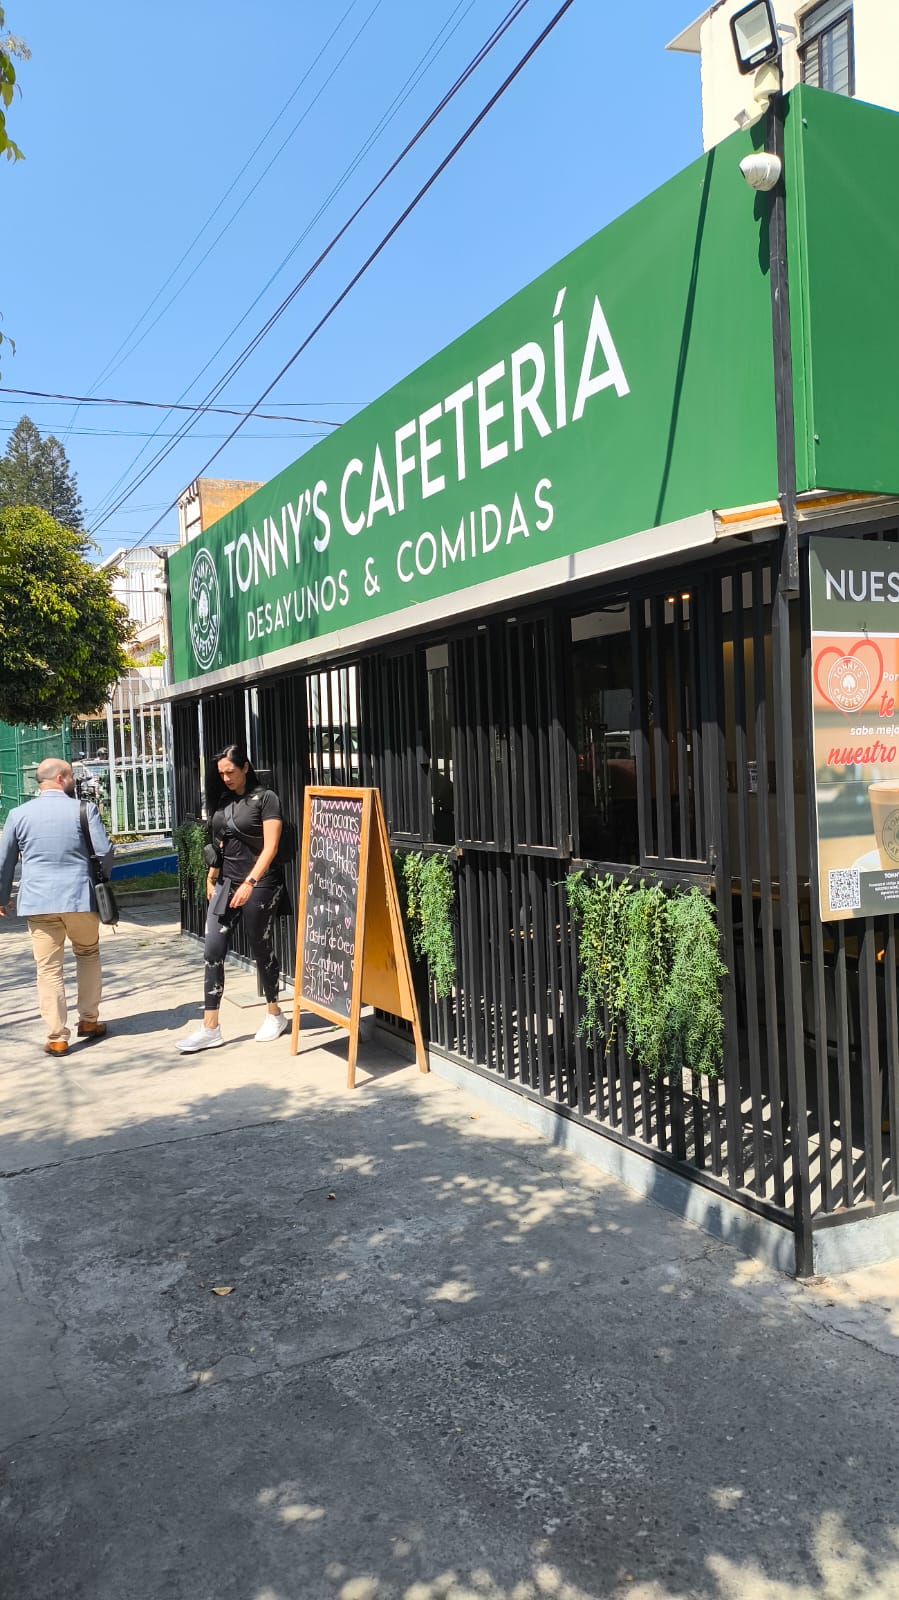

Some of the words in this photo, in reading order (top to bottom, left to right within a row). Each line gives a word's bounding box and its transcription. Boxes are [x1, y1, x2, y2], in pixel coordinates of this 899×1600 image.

[224, 479, 332, 599] TONNY'S
[340, 286, 631, 537] CAFETERÍA
[246, 568, 350, 642] DESAYUNOS
[364, 556, 381, 598] &
[396, 477, 555, 584] COMIDAS
[825, 569, 899, 603] NUES
[879, 690, 896, 718] te
[850, 726, 875, 736] sabe
[827, 740, 897, 766] nuestro
[305, 914, 327, 947] Pastel
